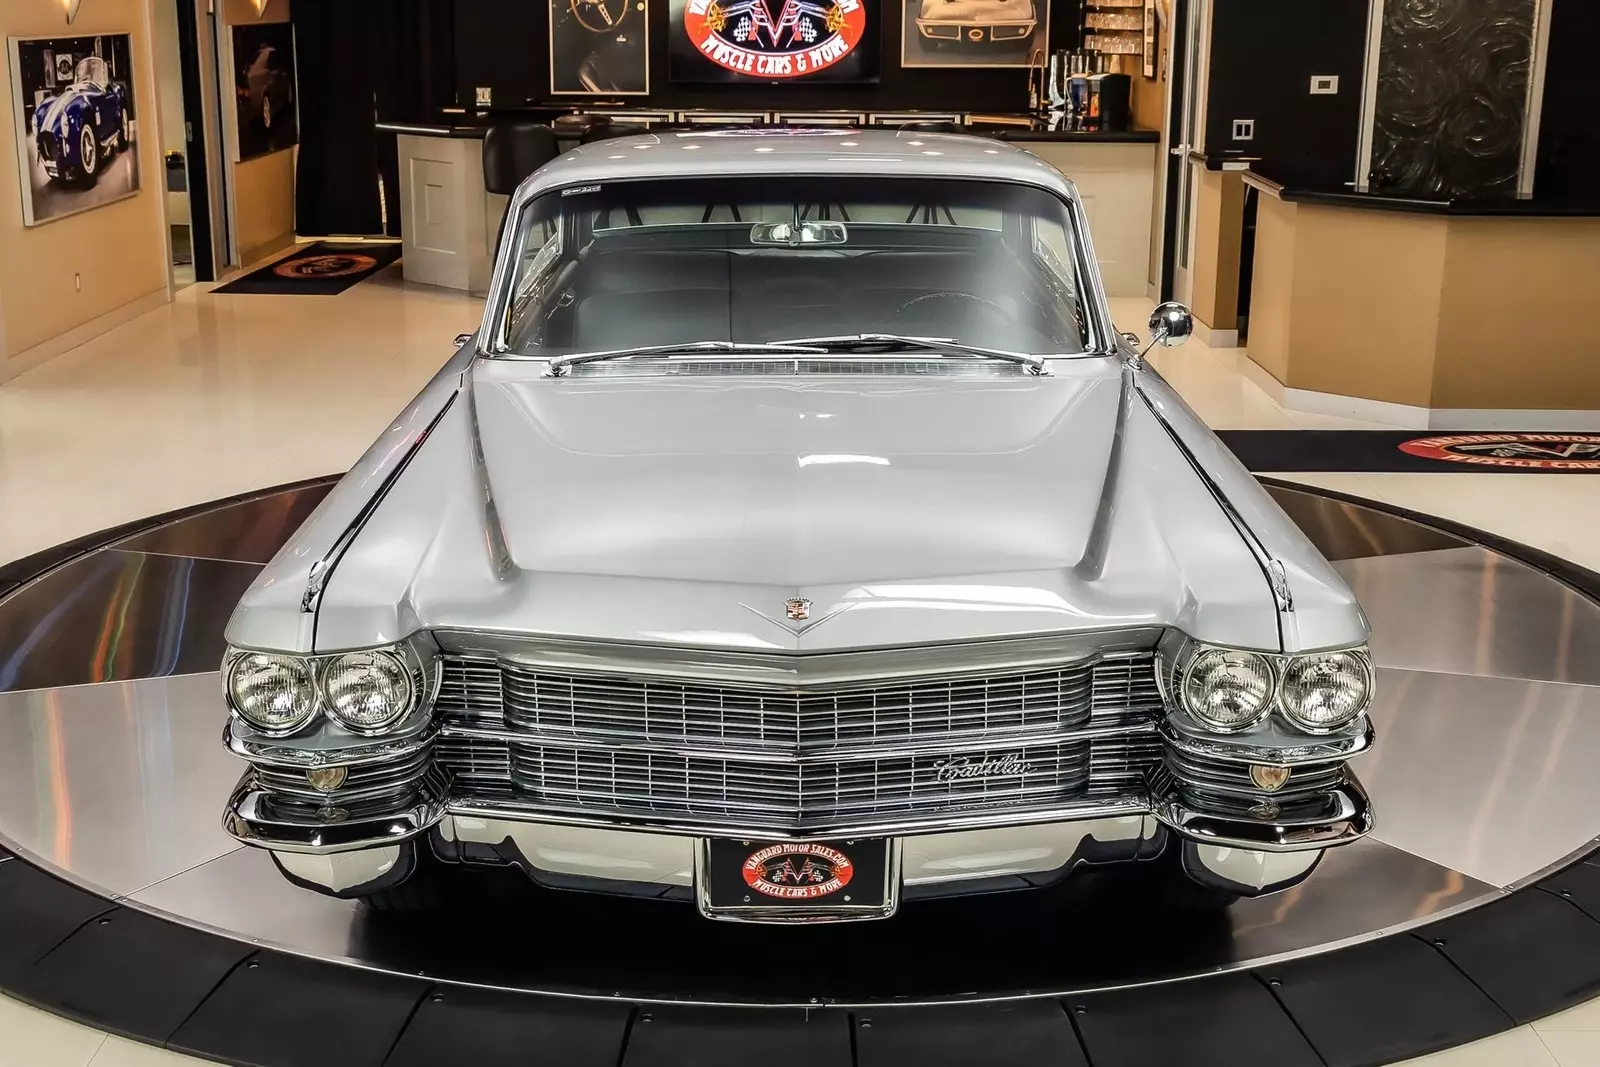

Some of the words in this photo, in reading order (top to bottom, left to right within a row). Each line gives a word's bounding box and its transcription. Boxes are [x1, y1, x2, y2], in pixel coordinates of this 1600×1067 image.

[700, 34, 755, 73] MUSCLE
[756, 55, 792, 75] CARS
[795, 53, 807, 72] &
[808, 33, 849, 69] MORE
[1551, 461, 1600, 469] CAR
[746, 844, 782, 870] VANGUARD
[782, 843, 810, 853] MOTOR
[810, 844, 850, 869] SALES.COM
[752, 878, 786, 896] MUSCLE
[786, 888, 808, 897] CARS
[810, 886, 817, 896] &
[819, 878, 843, 894] MORE
